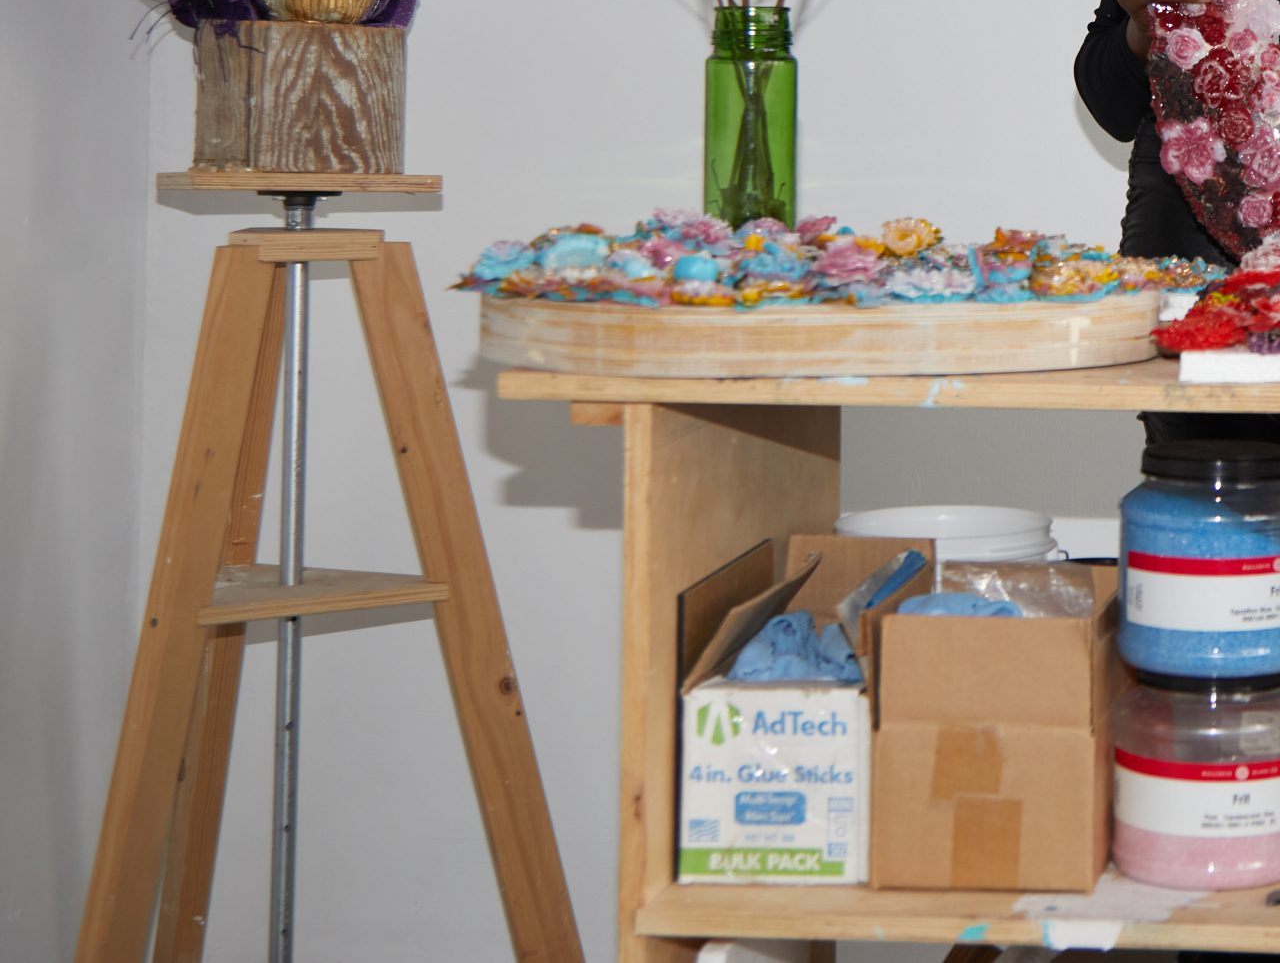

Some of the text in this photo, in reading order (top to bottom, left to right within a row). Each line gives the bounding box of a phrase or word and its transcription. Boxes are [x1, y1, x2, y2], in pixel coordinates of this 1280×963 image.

[752, 710, 847, 736] AdTech
[737, 765, 787, 783] Glue
[794, 764, 853, 783] Sticks
[708, 852, 821, 871] BULK PACK
